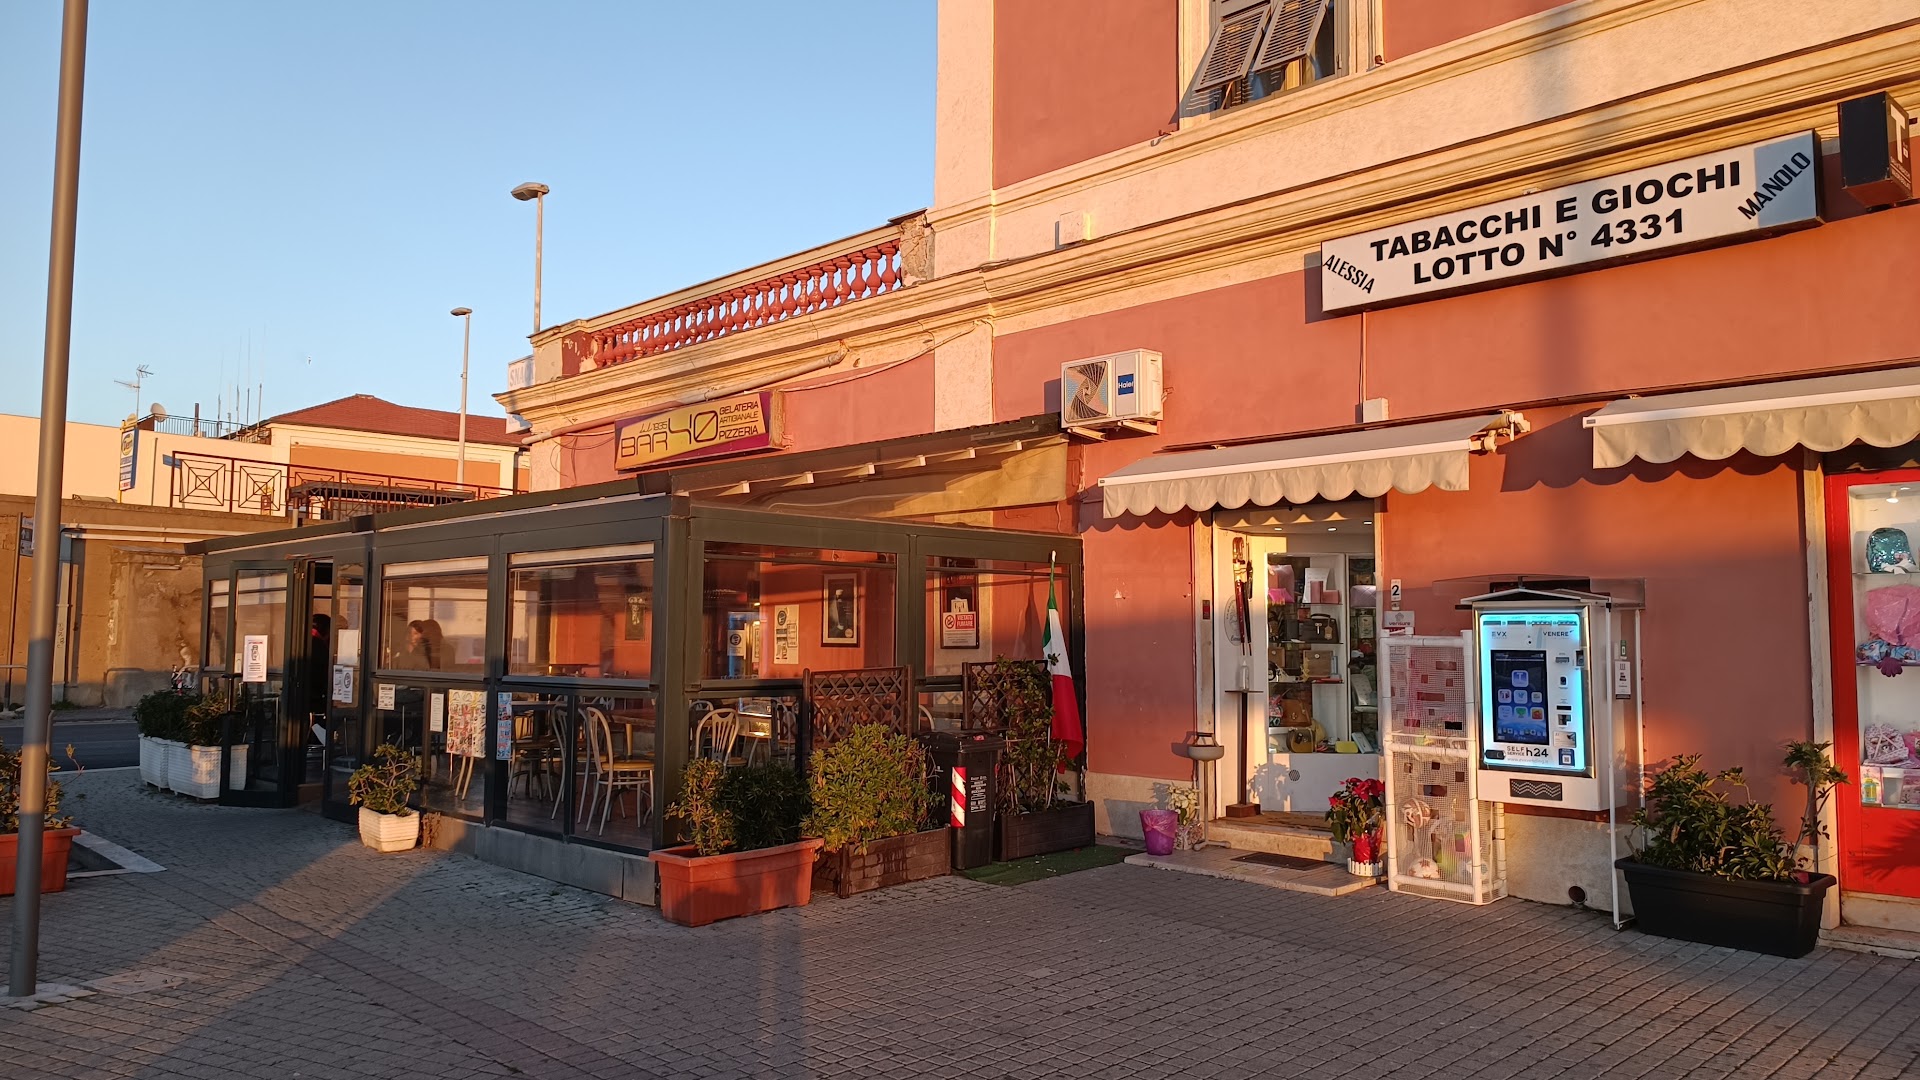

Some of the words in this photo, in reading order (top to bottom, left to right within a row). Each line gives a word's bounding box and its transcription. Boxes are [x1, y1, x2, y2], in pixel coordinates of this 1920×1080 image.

[1890, 104, 1906, 163] T
[1737, 152, 1811, 220] MANOLO
[1370, 205, 1541, 262] TABACCHI
[1556, 197, 1578, 223] E
[1592, 160, 1740, 214] GIOCHI
[1414, 242, 1525, 284] LOTTO
[1539, 230, 1577, 260] N°
[1591, 208, 1683, 248] 4331
[1322, 254, 1376, 294] ALESSIA
[1118, 381, 1134, 389] Haier
[719, 401, 759, 415] GELATERIA
[719, 410, 759, 424] ARTIGIANALE
[718, 425, 759, 440] PIZZERIA
[621, 430, 668, 458] BAR
[1391, 584, 1400, 596] 2
[1526, 747, 1549, 757] h24
